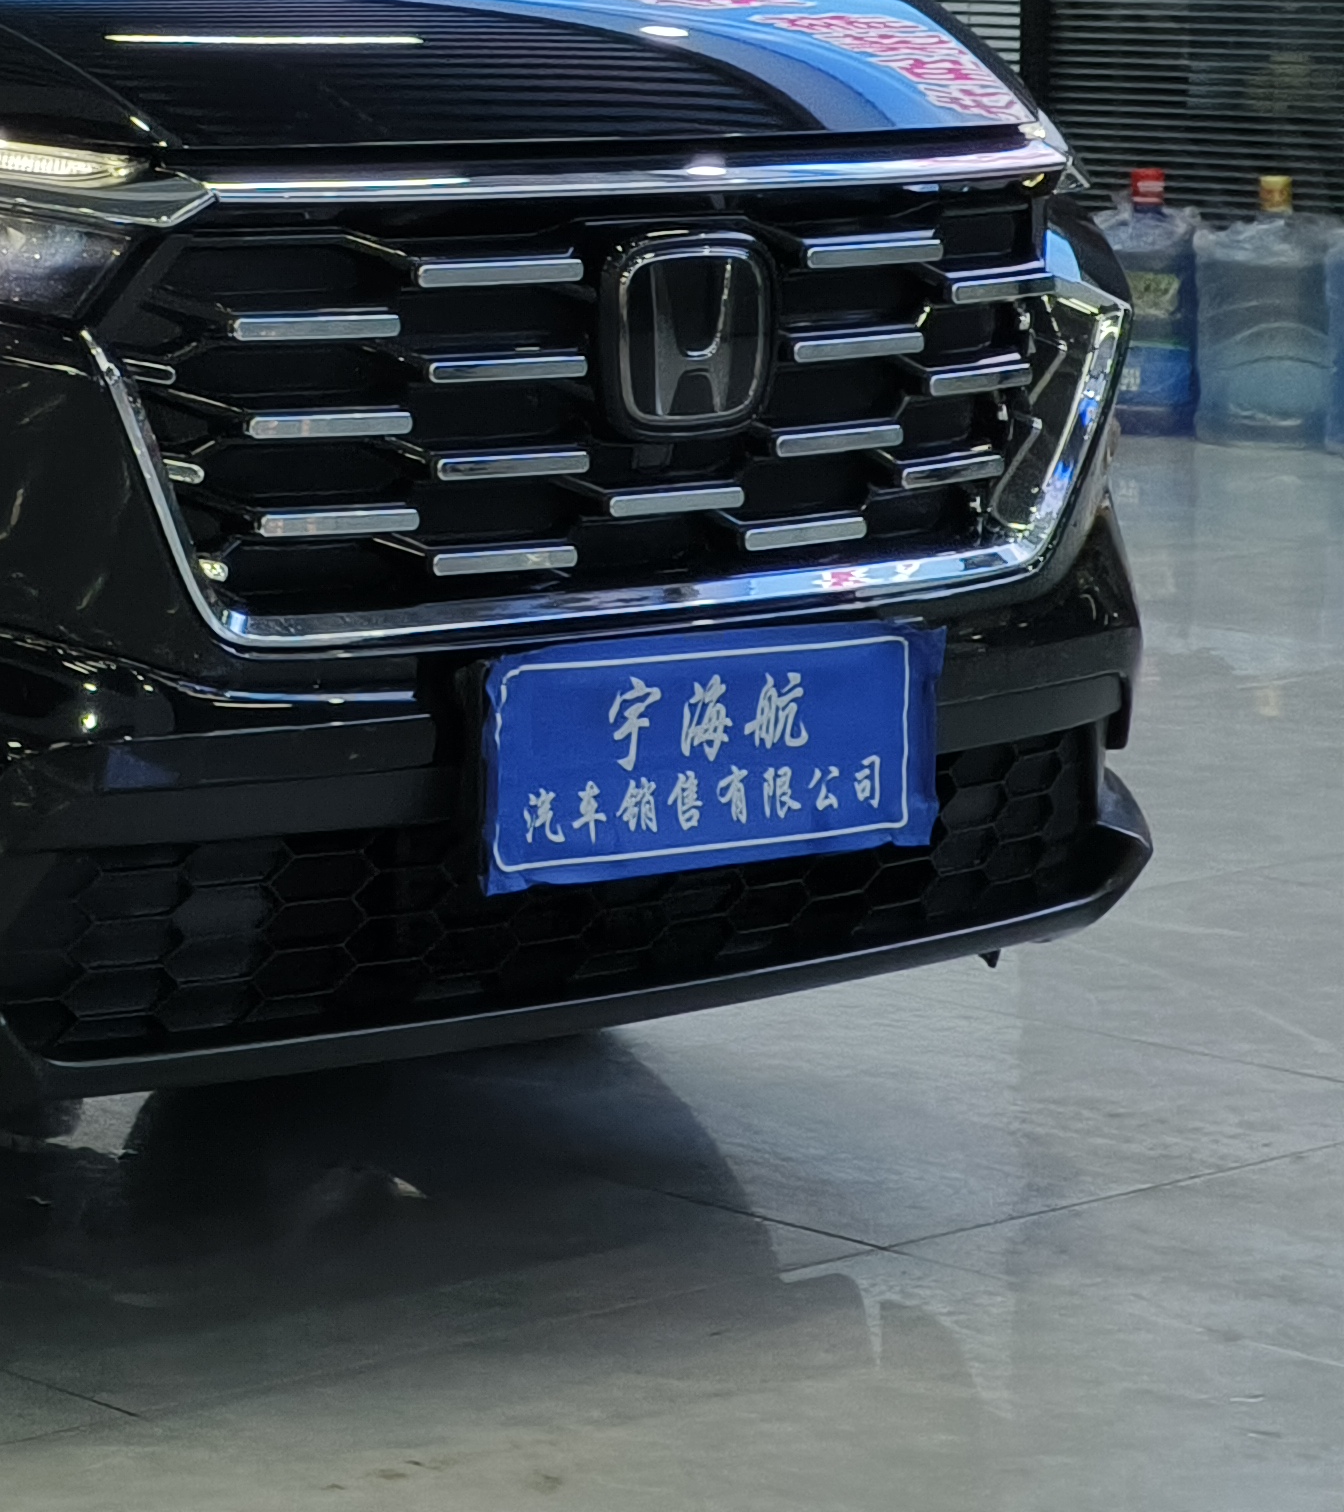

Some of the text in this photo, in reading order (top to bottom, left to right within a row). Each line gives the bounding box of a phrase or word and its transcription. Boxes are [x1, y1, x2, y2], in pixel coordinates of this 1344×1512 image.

[608, 672, 809, 772] 宇海航
[522, 754, 882, 845] 汽车销售有限公司
